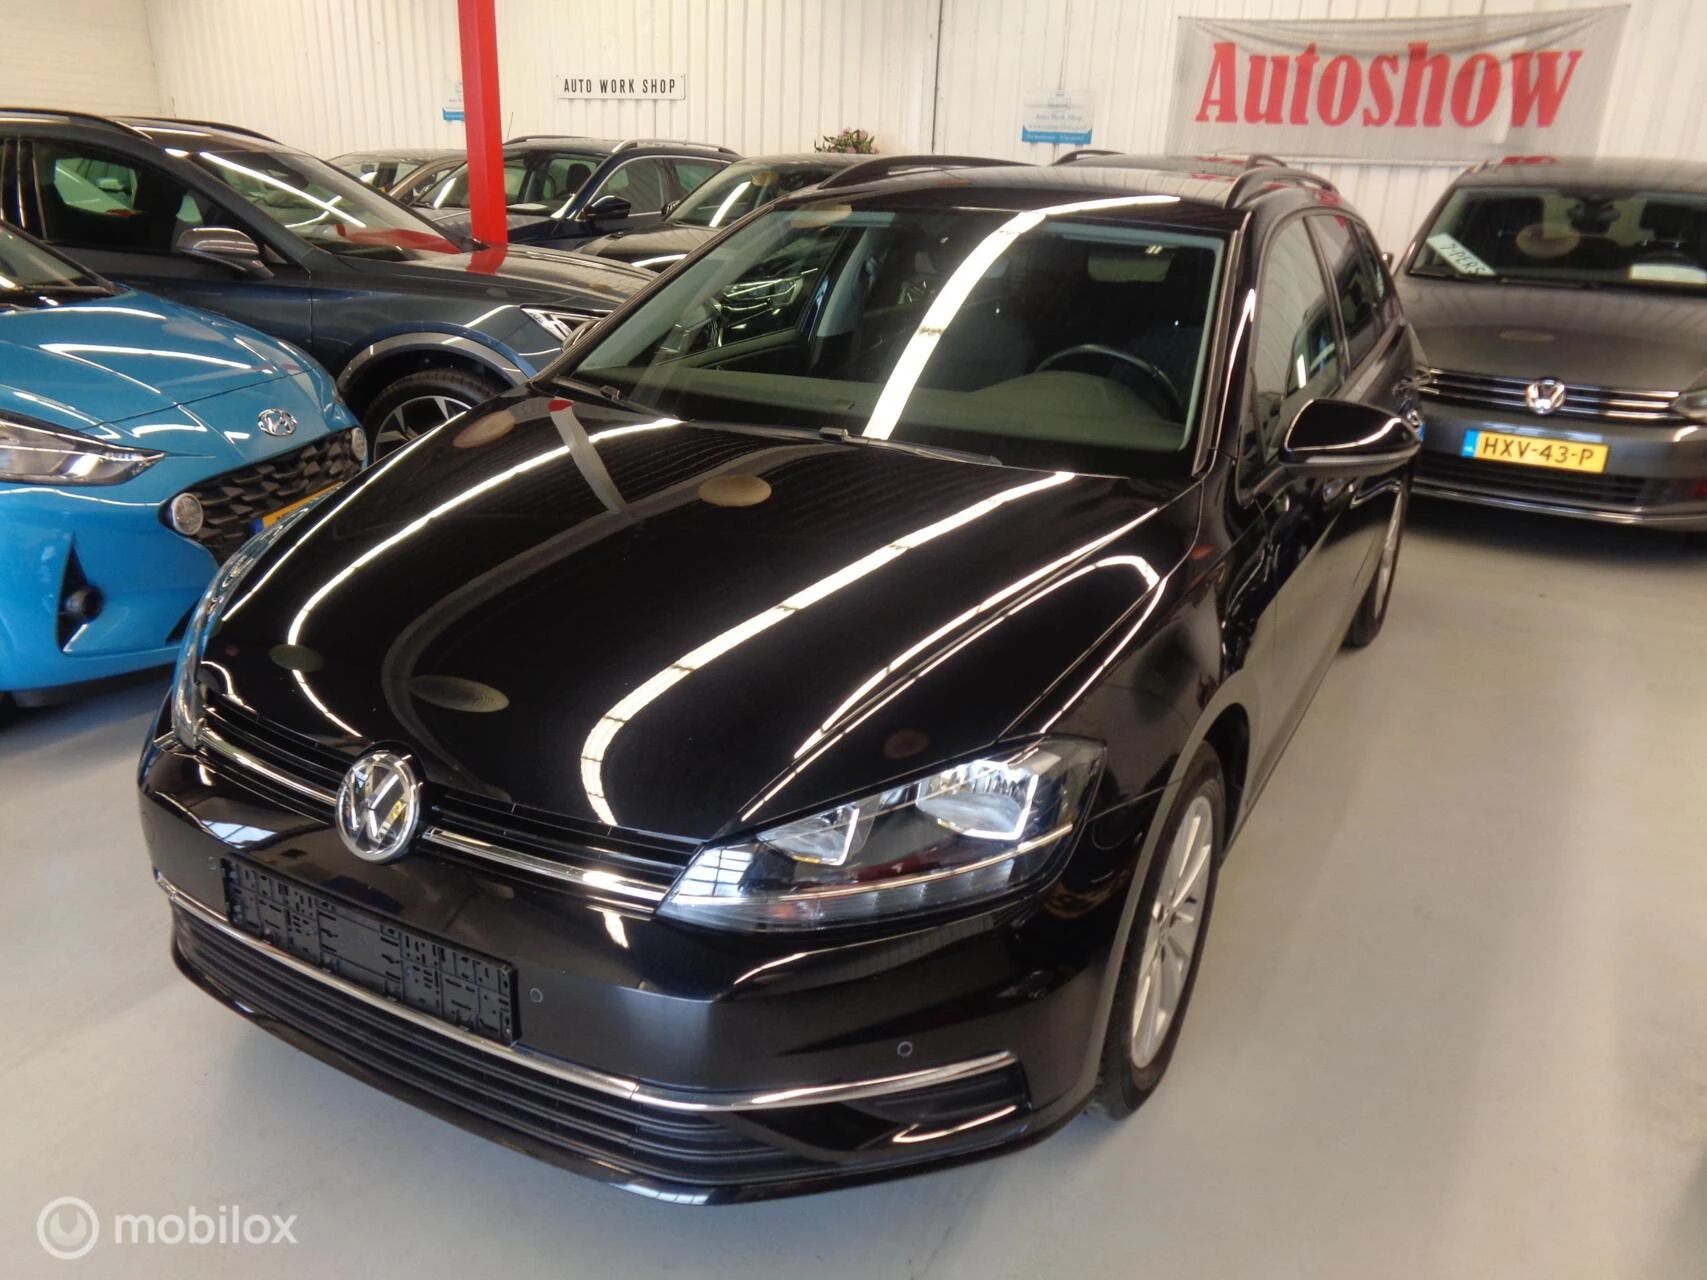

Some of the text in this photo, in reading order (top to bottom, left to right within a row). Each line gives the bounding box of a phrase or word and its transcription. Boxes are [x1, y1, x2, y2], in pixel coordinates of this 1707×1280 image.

[564, 78, 676, 94] AUTO WORK SHOP
[1194, 41, 1583, 128] Autoshow
[1482, 436, 1595, 467] HXV-43-P
